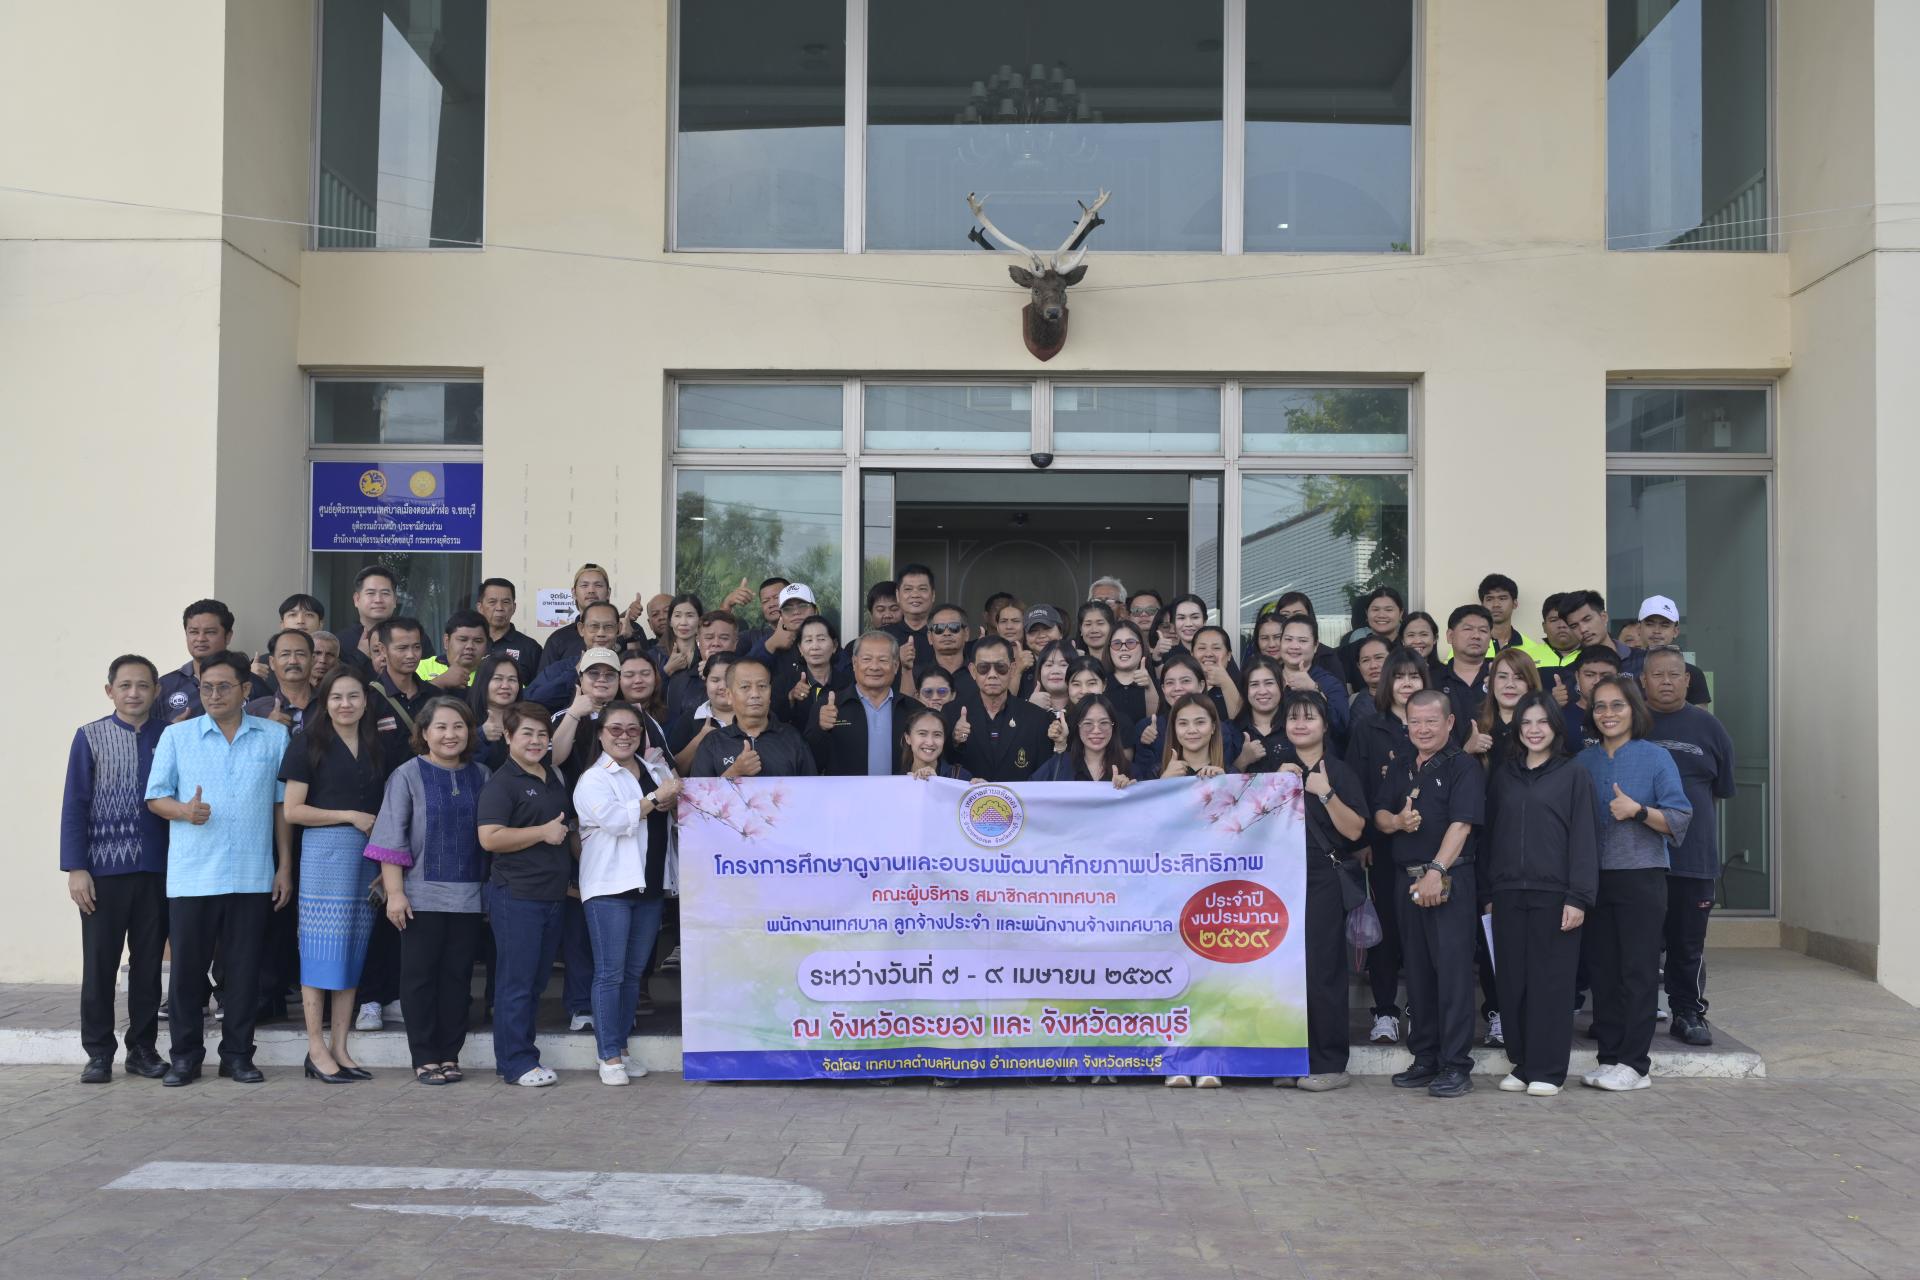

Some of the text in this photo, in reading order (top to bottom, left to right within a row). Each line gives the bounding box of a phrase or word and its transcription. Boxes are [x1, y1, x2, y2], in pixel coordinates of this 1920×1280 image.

[451, 503, 476, 518] จ.ชลบุรี
[415, 534, 461, 547] กระทรวงยุติธรรม
[714, 852, 1264, 878] โครงการศึกษาดูงานและอบรมพัฒนาศักยภาพประสิทธิภาพ
[872, 884, 1116, 905] คณะผู้บริหาร สมาชิกสภาเทศบาล
[1204, 890, 1264, 908] ประจำปี
[767, 912, 1173, 936] พนักงานเทศบาล ลูกจ้างประจำ และพนักงานจ้างเทศบาล
[1190, 908, 1279, 925] งบประมาณ
[1199, 928, 1270, 949] ๒๕๖๙
[810, 954, 933, 986] ระหว่างวันที่
[942, 966, 959, 985] ๗
[985, 965, 1004, 983] ๙
[1013, 966, 1096, 985] เมษายน
[1104, 966, 1174, 985] ๒๕๖๙
[794, 1008, 1189, 1040] ณ จังหวัดระยอง และ จังหวัดชลบุรี
[822, 1053, 1163, 1073] จัดโดย เทศบาลตำบลหินกอง อำเภอหนองแค จังหวัดสระบุรี
